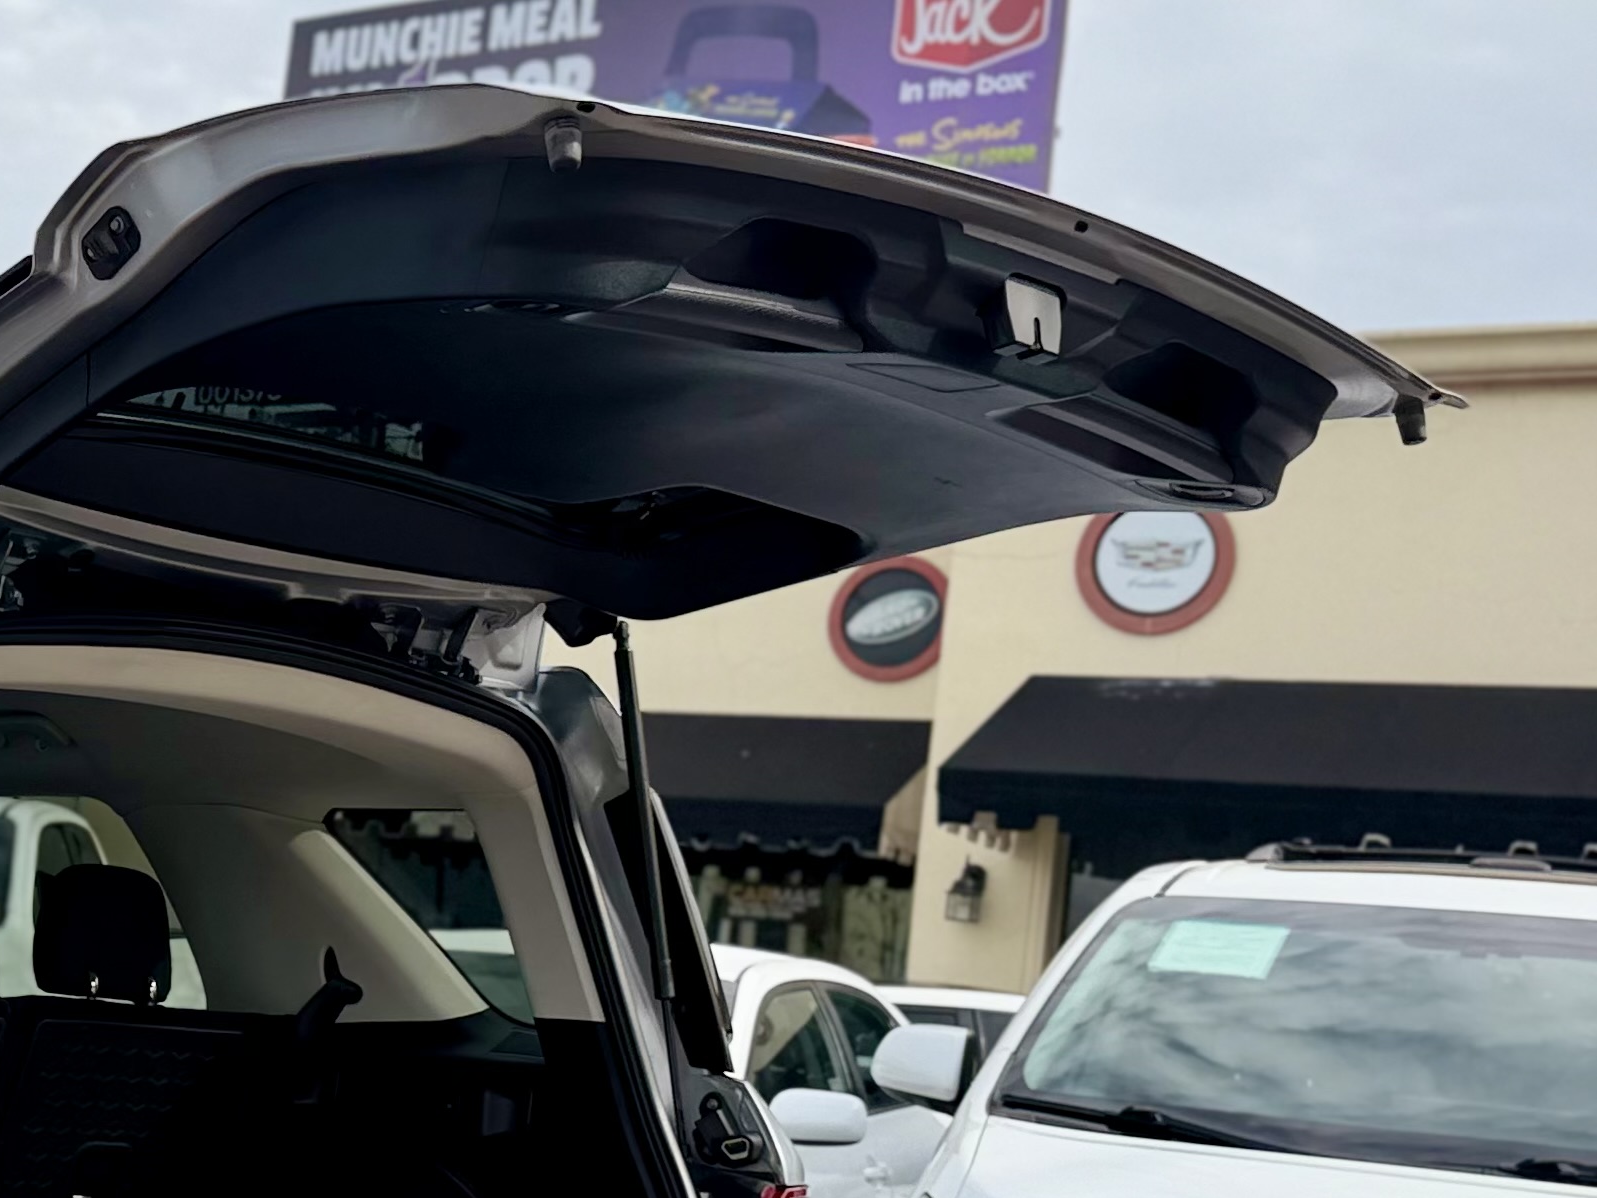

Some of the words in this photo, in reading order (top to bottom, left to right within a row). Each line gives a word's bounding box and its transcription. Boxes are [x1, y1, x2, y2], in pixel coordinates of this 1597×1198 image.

[310, 8, 485, 77] MUNCHIE
[487, 0, 602, 50] MEAL
[928, 76, 971, 100] the
[975, 70, 1030, 95] box
